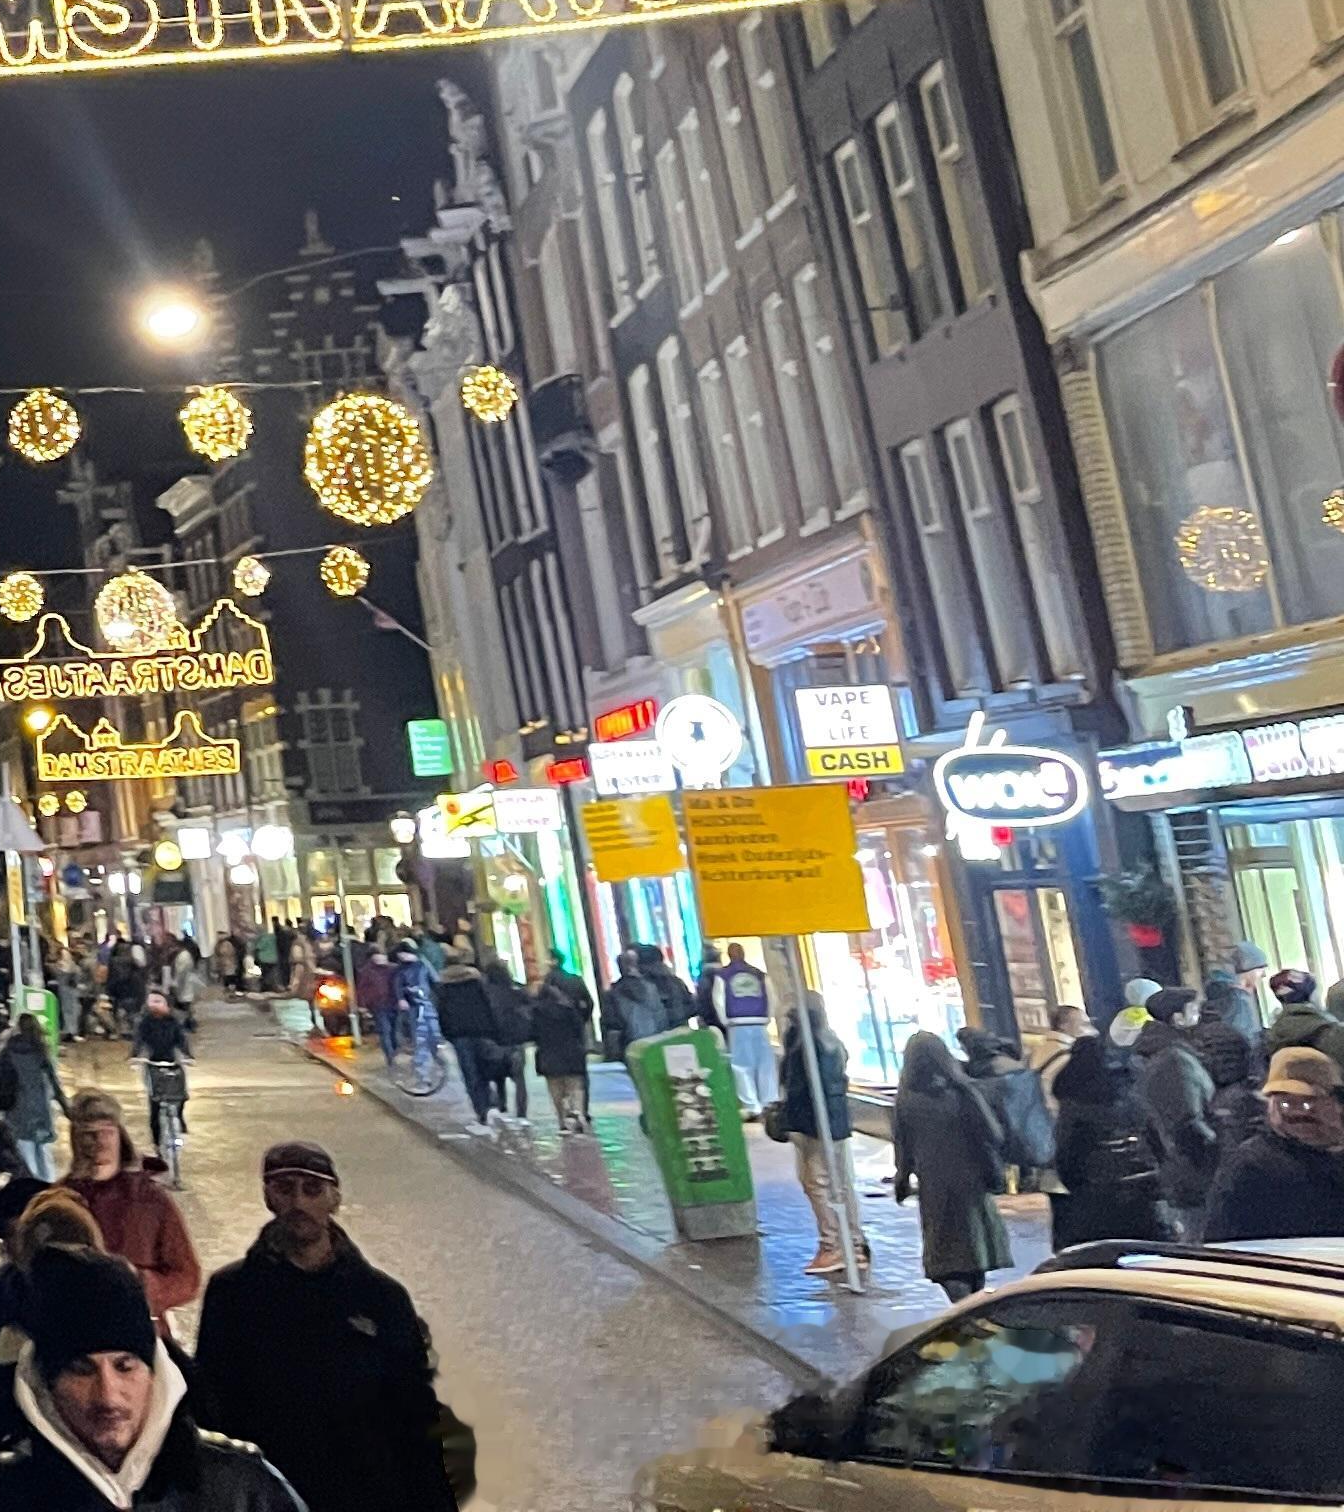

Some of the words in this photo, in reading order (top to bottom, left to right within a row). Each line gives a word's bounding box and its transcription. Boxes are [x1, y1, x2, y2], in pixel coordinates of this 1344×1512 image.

[815, 691, 872, 706] VAPE
[840, 709, 853, 722] 4
[829, 725, 870, 741] LIFE
[42, 745, 233, 778] DAMSTRAATJES
[820, 750, 890, 771] CASH
